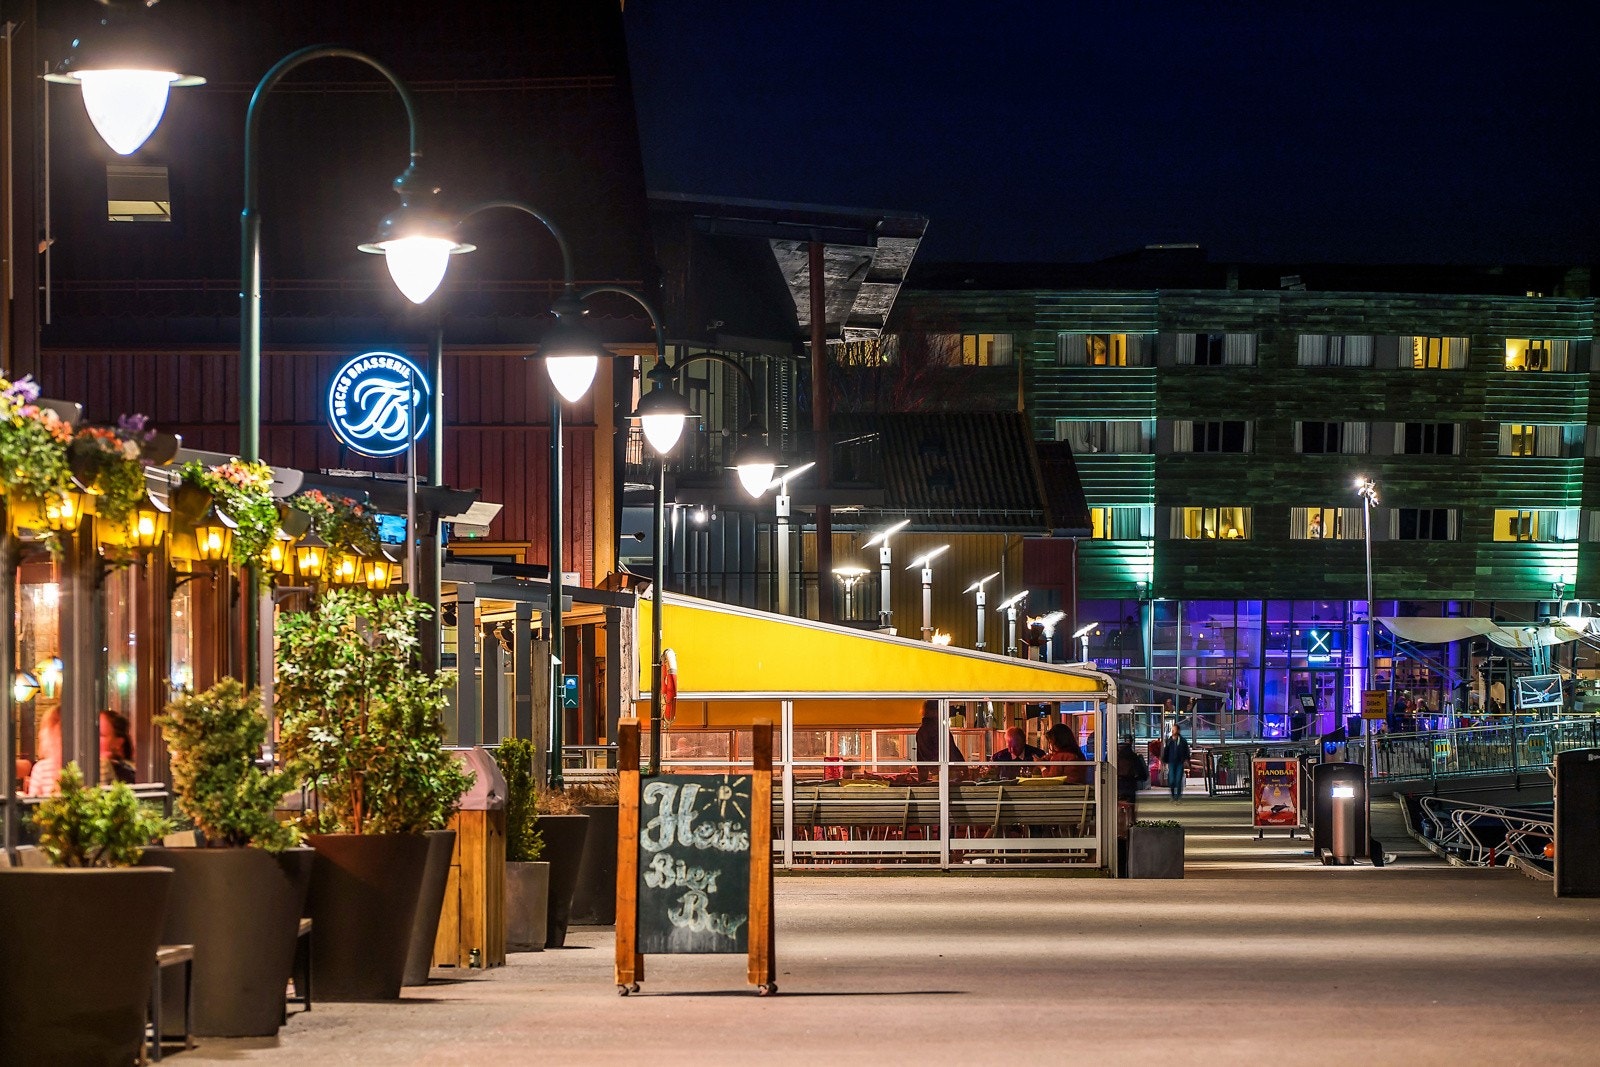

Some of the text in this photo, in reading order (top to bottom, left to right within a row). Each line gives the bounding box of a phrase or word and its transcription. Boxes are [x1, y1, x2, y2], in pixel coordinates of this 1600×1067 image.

[335, 357, 411, 417] BECKS BRASSERIE
[643, 852, 721, 893] Bier
[667, 890, 747, 940] Bar
